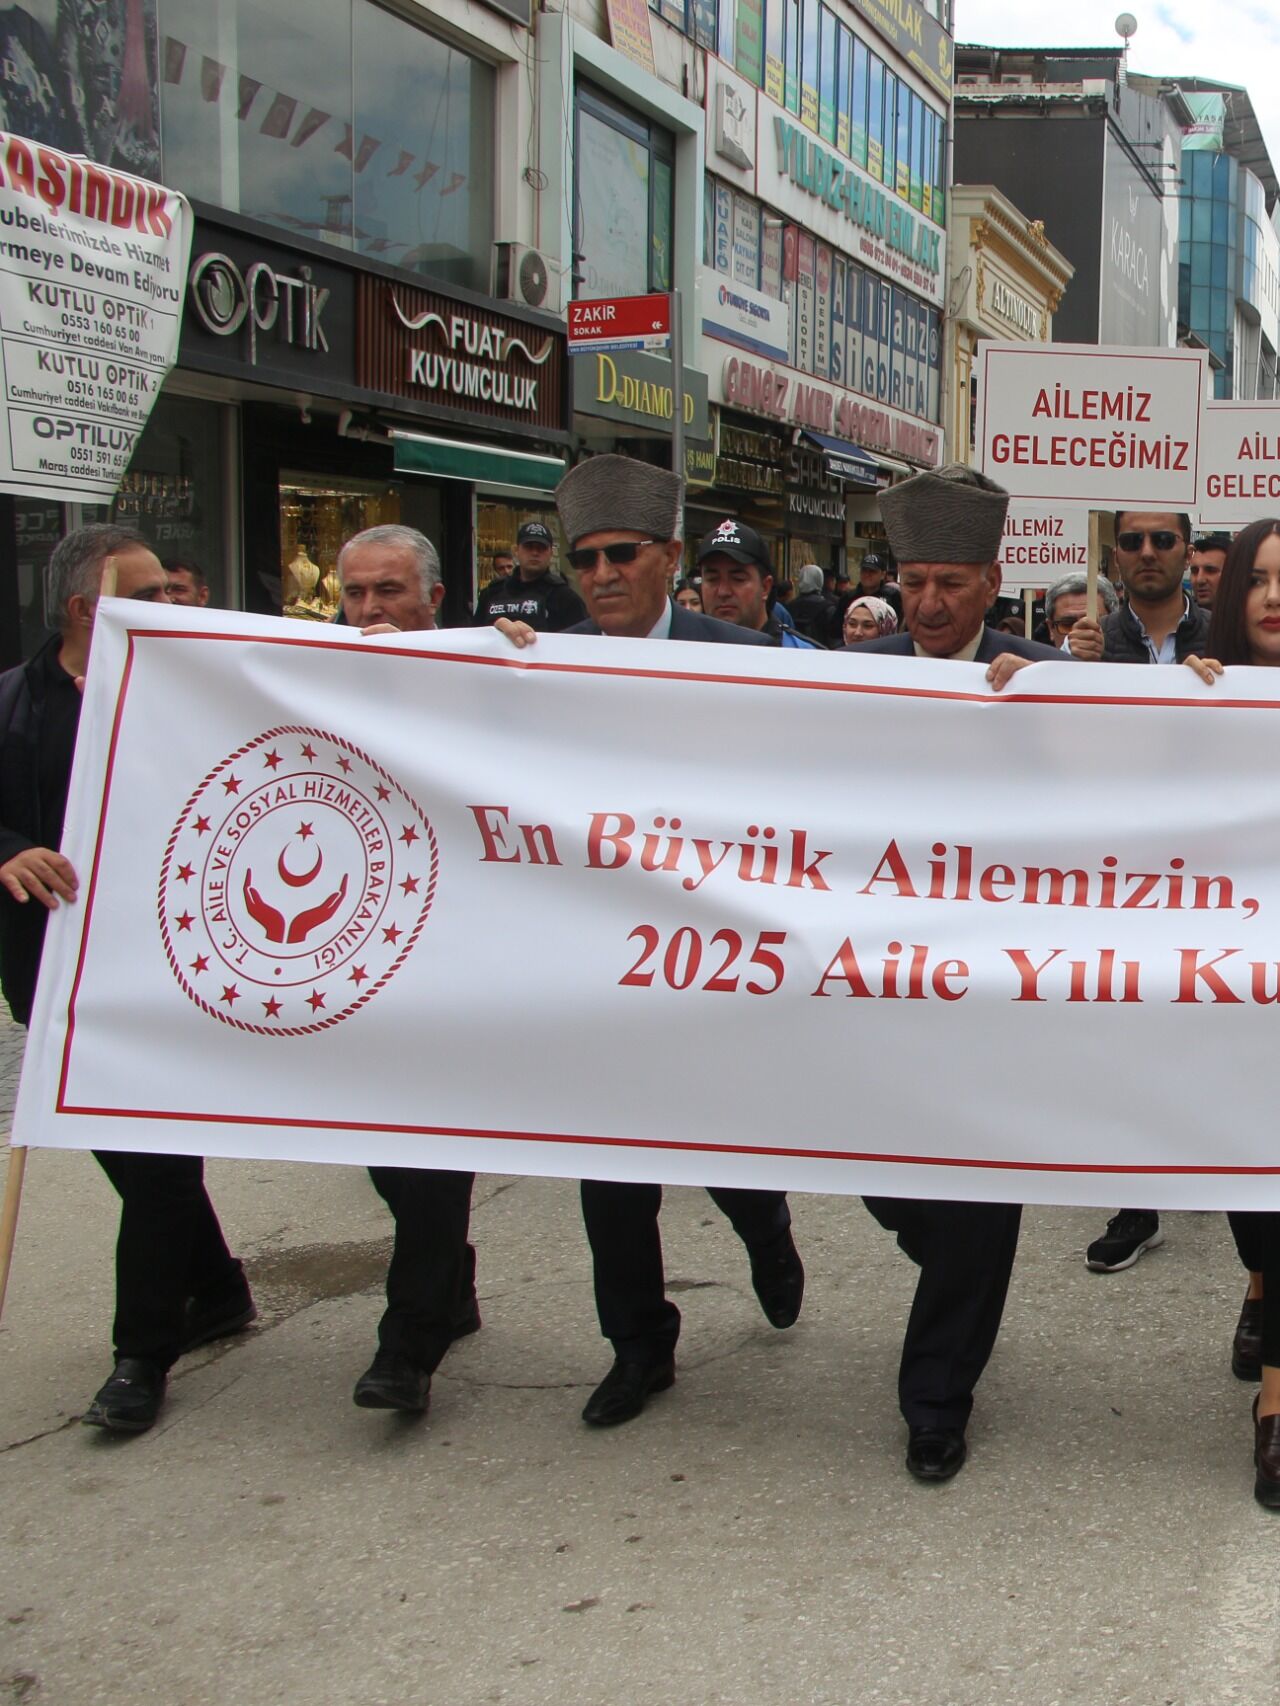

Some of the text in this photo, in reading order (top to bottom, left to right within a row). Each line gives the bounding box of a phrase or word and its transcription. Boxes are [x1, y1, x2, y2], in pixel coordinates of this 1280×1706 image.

[2, 58, 115, 118] RADA
[0, 134, 172, 240] AŞINDIK
[0, 207, 170, 272] ubelerimizde Hizmet
[1111, 217, 1149, 297] KARACA
[0, 242, 179, 302] rmeye Devam Ediyoru
[800, 273, 813, 291] ENEL
[28, 282, 95, 315] KUTLU
[573, 305, 616, 323] ZAKİR
[833, 262, 926, 356] Allianz
[23, 320, 81, 344] Cumhuriyet
[83, 335, 117, 351] caddesi
[119, 342, 134, 355] Van
[61, 313, 140, 342] 0553 160 65 00
[450, 315, 505, 362] FUAT
[573, 326, 602, 336] SOKAK
[817, 296, 826, 365] DEPREM
[38, 350, 99, 381] KUTLU
[410, 348, 539, 411] KUYUMCULUK
[832, 338, 926, 414] SİGORTA
[11, 385, 62, 406] Cumhuriyet
[64, 397, 96, 411] caddesi
[67, 380, 139, 406] 0516 165 00 65
[596, 353, 694, 424] D DIAMOD
[1031, 382, 1152, 423] AİLEMİZ
[39, 459, 68, 477] Maraş
[71, 464, 101, 478] caddesi
[71, 447, 93, 462] 0551
[97, 452, 111, 466] 591
[991, 431, 1189, 471] GELECEĞİMİZ
[789, 495, 846, 520] KUYUMCULUK
[998, 542, 1087, 564] ECEĞİMİZ
[227, 783, 297, 840] SOSYAL
[303, 777, 384, 854] HİZMETLER
[212, 845, 232, 871] VE
[466, 803, 563, 867] En
[584, 811, 833, 892] Büyük
[857, 838, 1260, 919] Ailemizin,
[205, 879, 225, 923] AİLE
[315, 861, 385, 970] BAKANLIĞI
[617, 923, 788, 996] 2025
[810, 935, 970, 1001] Aile
[1001, 947, 1144, 1003] Yılı
